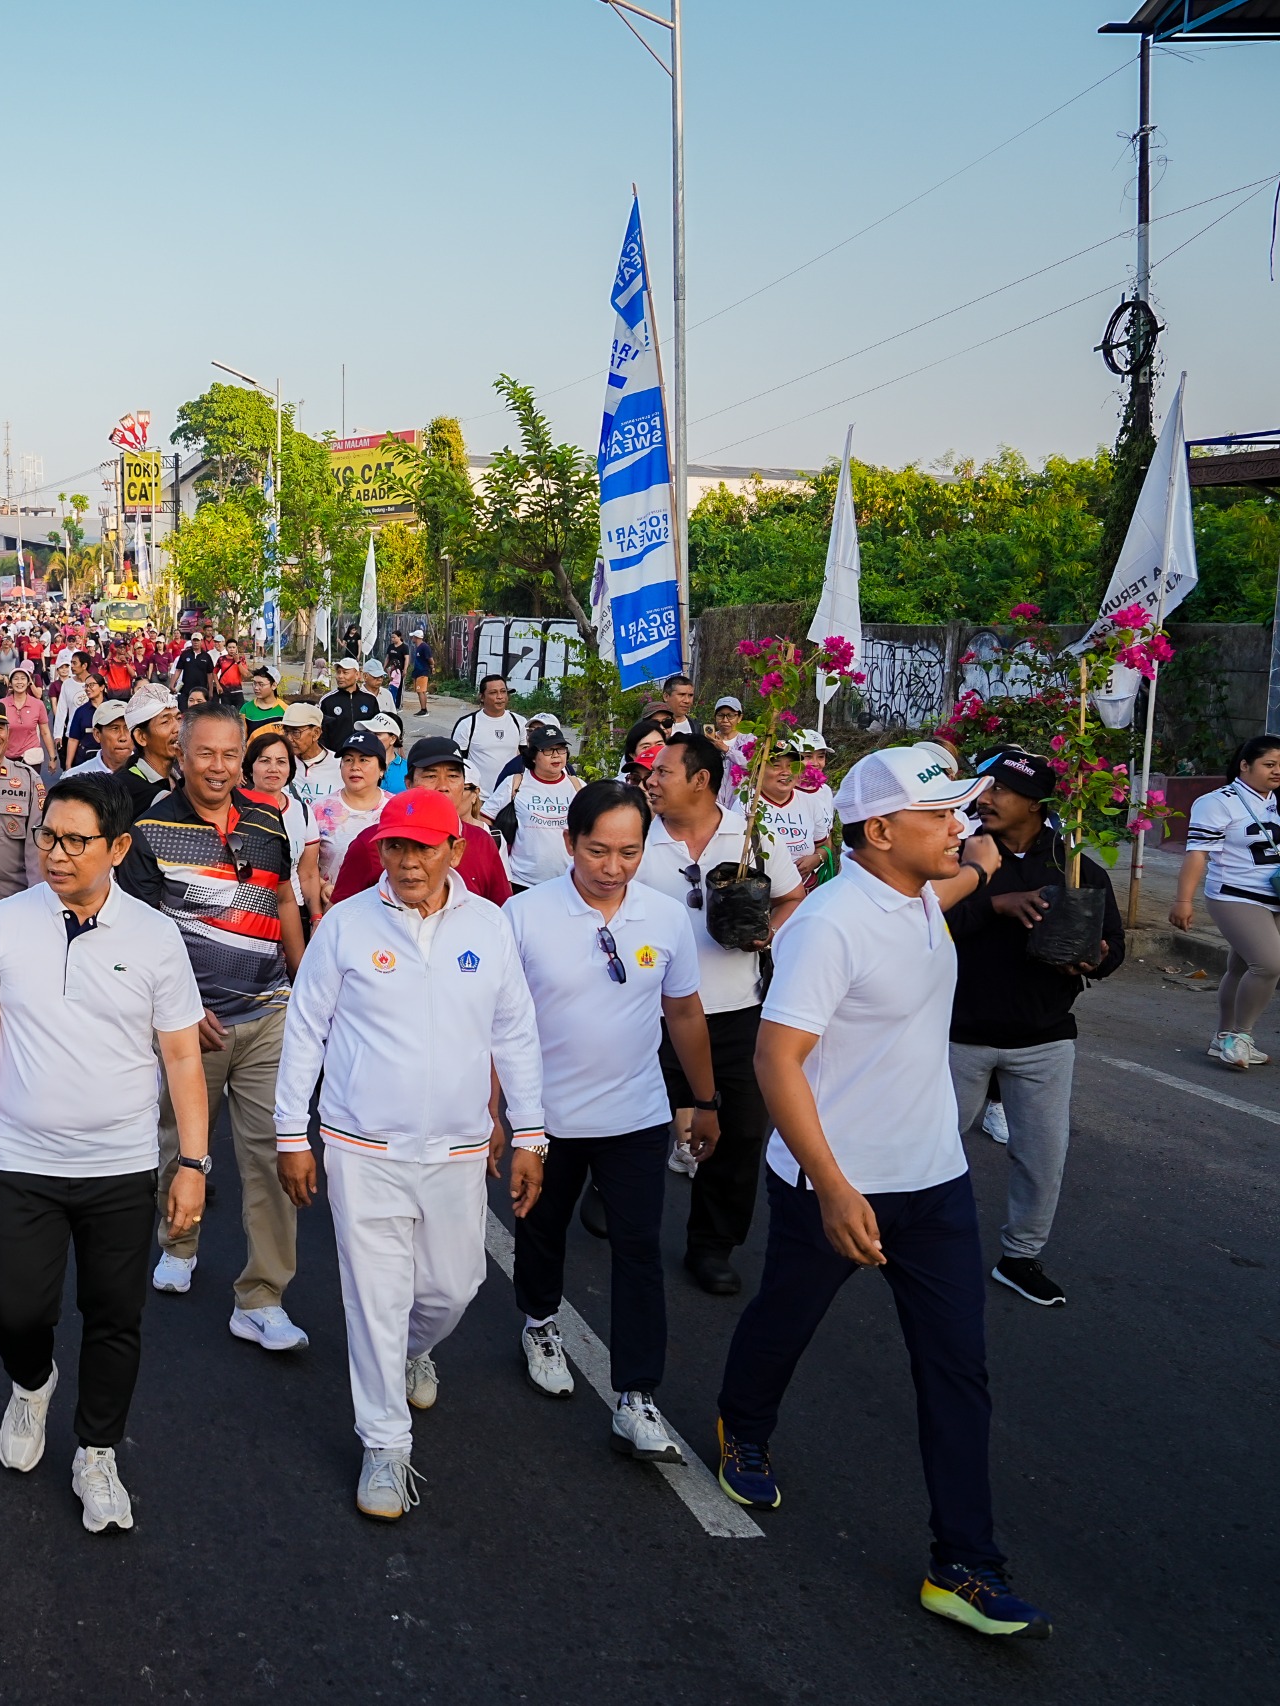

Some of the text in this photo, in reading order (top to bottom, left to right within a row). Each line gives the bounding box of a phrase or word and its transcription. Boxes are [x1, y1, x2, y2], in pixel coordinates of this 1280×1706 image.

[344, 437, 370, 449] MALAM
[126, 462, 160, 477] TOKO
[127, 481, 158, 501] CAT
[355, 486, 391, 502] ABADI
[1003, 759, 1036, 776] BINTANG
[1, 789, 27, 798] POLRI
[532, 795, 570, 805] BALI
[527, 803, 568, 814] happ
[763, 812, 803, 825] BALI
